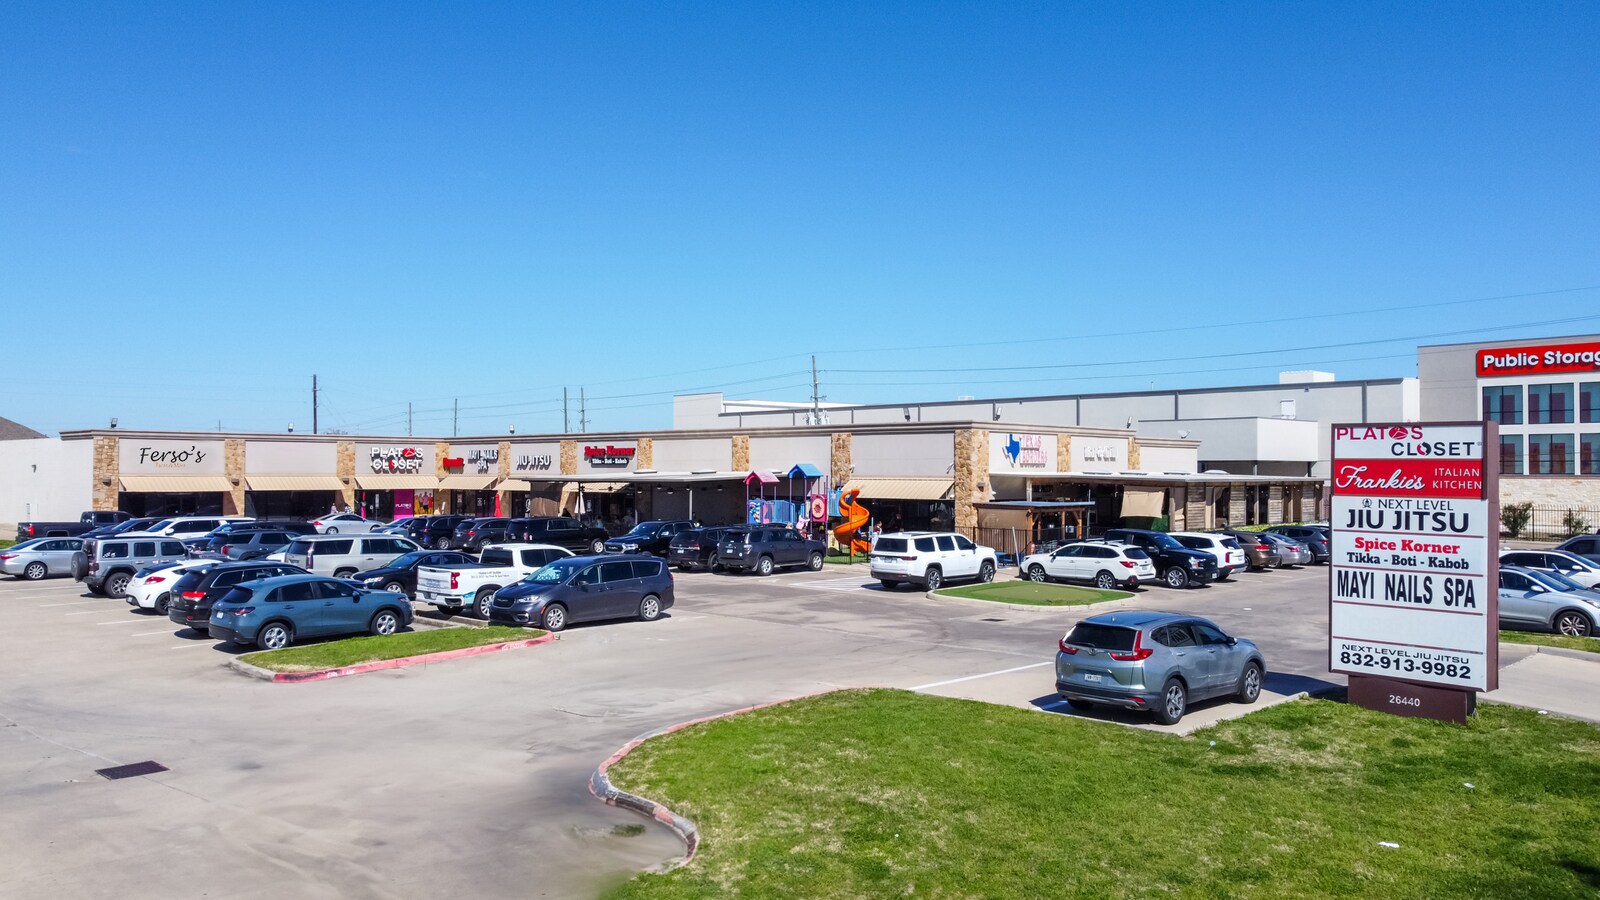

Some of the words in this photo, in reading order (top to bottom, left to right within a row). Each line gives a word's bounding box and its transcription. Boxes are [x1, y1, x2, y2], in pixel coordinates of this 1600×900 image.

[1483, 353, 1539, 368] Public
[140, 446, 206, 464] Ferso's
[584, 446, 605, 458] Spice
[606, 446, 635, 456] Korner
[1391, 441, 1475, 456] CLOSET
[373, 459, 422, 469] CLOSET
[529, 455, 551, 466] JITSU
[1335, 465, 1425, 490] Frankie's
[1434, 467, 1480, 477] ITALIAN
[1432, 480, 1482, 490] KITCHEN
[1378, 499, 1412, 510] NEXT
[1416, 500, 1454, 511] LEVEL
[1346, 509, 1384, 529] JIU
[1392, 511, 1469, 533] JITSU
[1354, 537, 1396, 552] Spice
[1401, 539, 1460, 554] Korner
[1347, 552, 1380, 565] Tikka
[1391, 554, 1417, 567] Boti
[1428, 556, 1469, 570] Kabob
[1337, 570, 1374, 599] MAYI
[1385, 573, 1433, 605] NAILS
[1443, 577, 1476, 609] SPA
[1341, 644, 1373, 653] NEXT
[1374, 647, 1411, 658] LEVEL
[1412, 652, 1431, 660] JIU
[1434, 655, 1469, 664] JITSU
[1340, 651, 1471, 680] 832-913-9982
[1389, 695, 1421, 707] 26440
